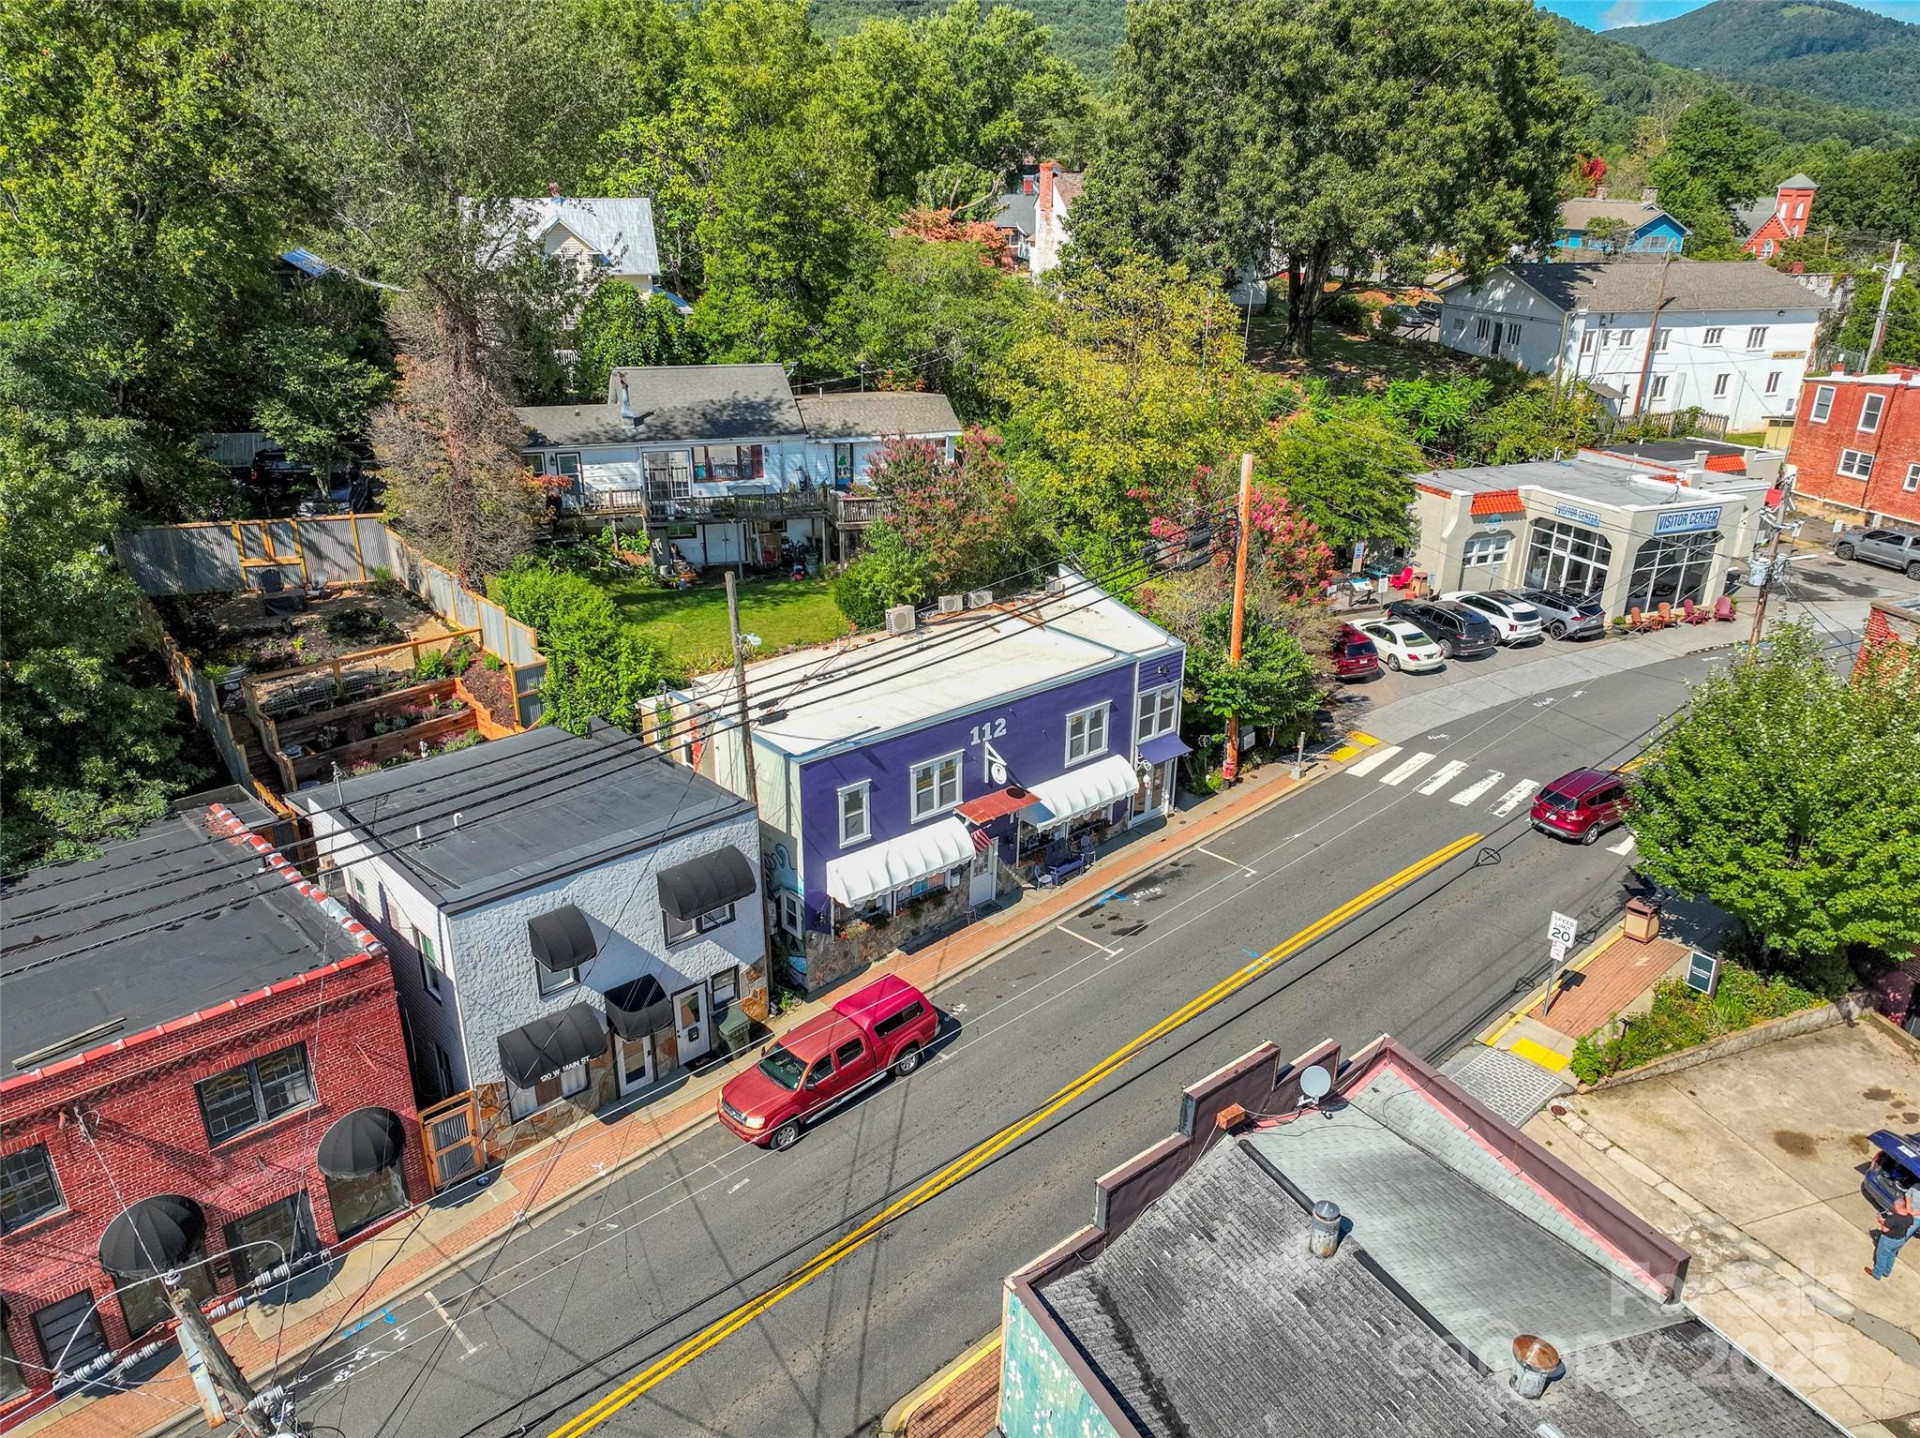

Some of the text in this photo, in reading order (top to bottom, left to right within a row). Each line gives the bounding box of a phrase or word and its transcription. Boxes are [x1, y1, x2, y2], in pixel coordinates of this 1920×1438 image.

[1558, 503, 1599, 525] VISITOR CENTER
[1658, 509, 1718, 530] VISITOR CENTER
[970, 717, 1007, 746] 112
[1553, 915, 1575, 928] SPEED
[1554, 921, 1572, 931] LIMIT
[1551, 927, 1571, 943] 20
[540, 1073, 552, 1083] 120
[562, 1060, 580, 1072] MAIN
